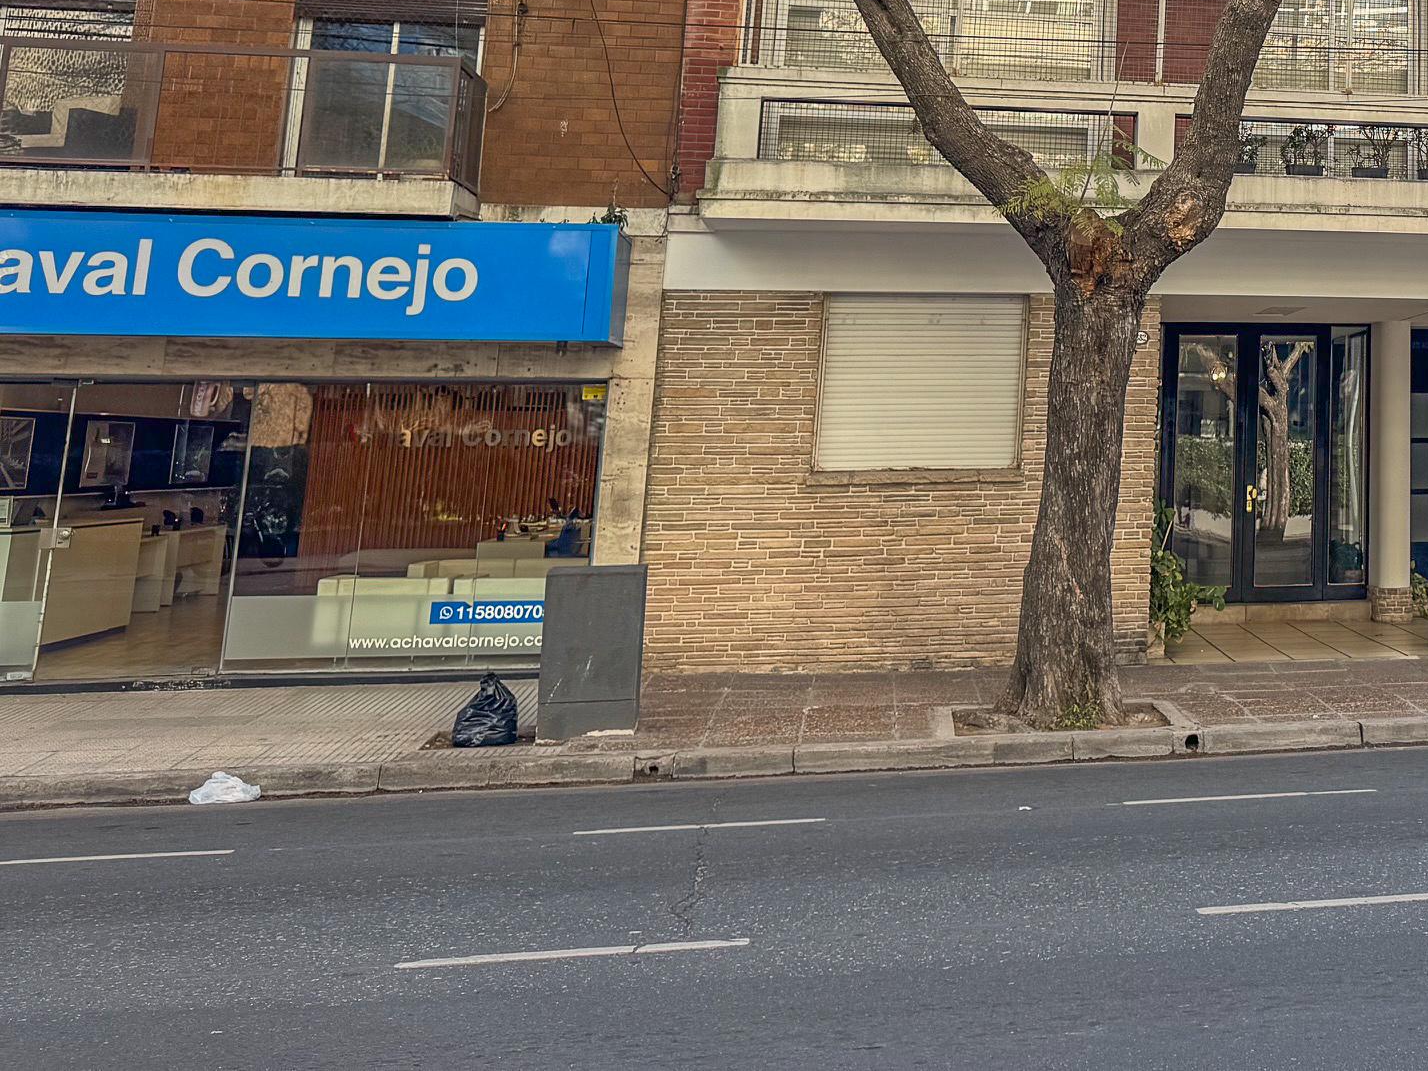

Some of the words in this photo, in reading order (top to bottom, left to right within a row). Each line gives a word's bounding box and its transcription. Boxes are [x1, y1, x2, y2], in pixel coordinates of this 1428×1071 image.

[0, 238, 153, 296] aval
[177, 237, 479, 316] Cornejo
[461, 424, 572, 453] Cornejo
[456, 604, 544, 620] 115808070
